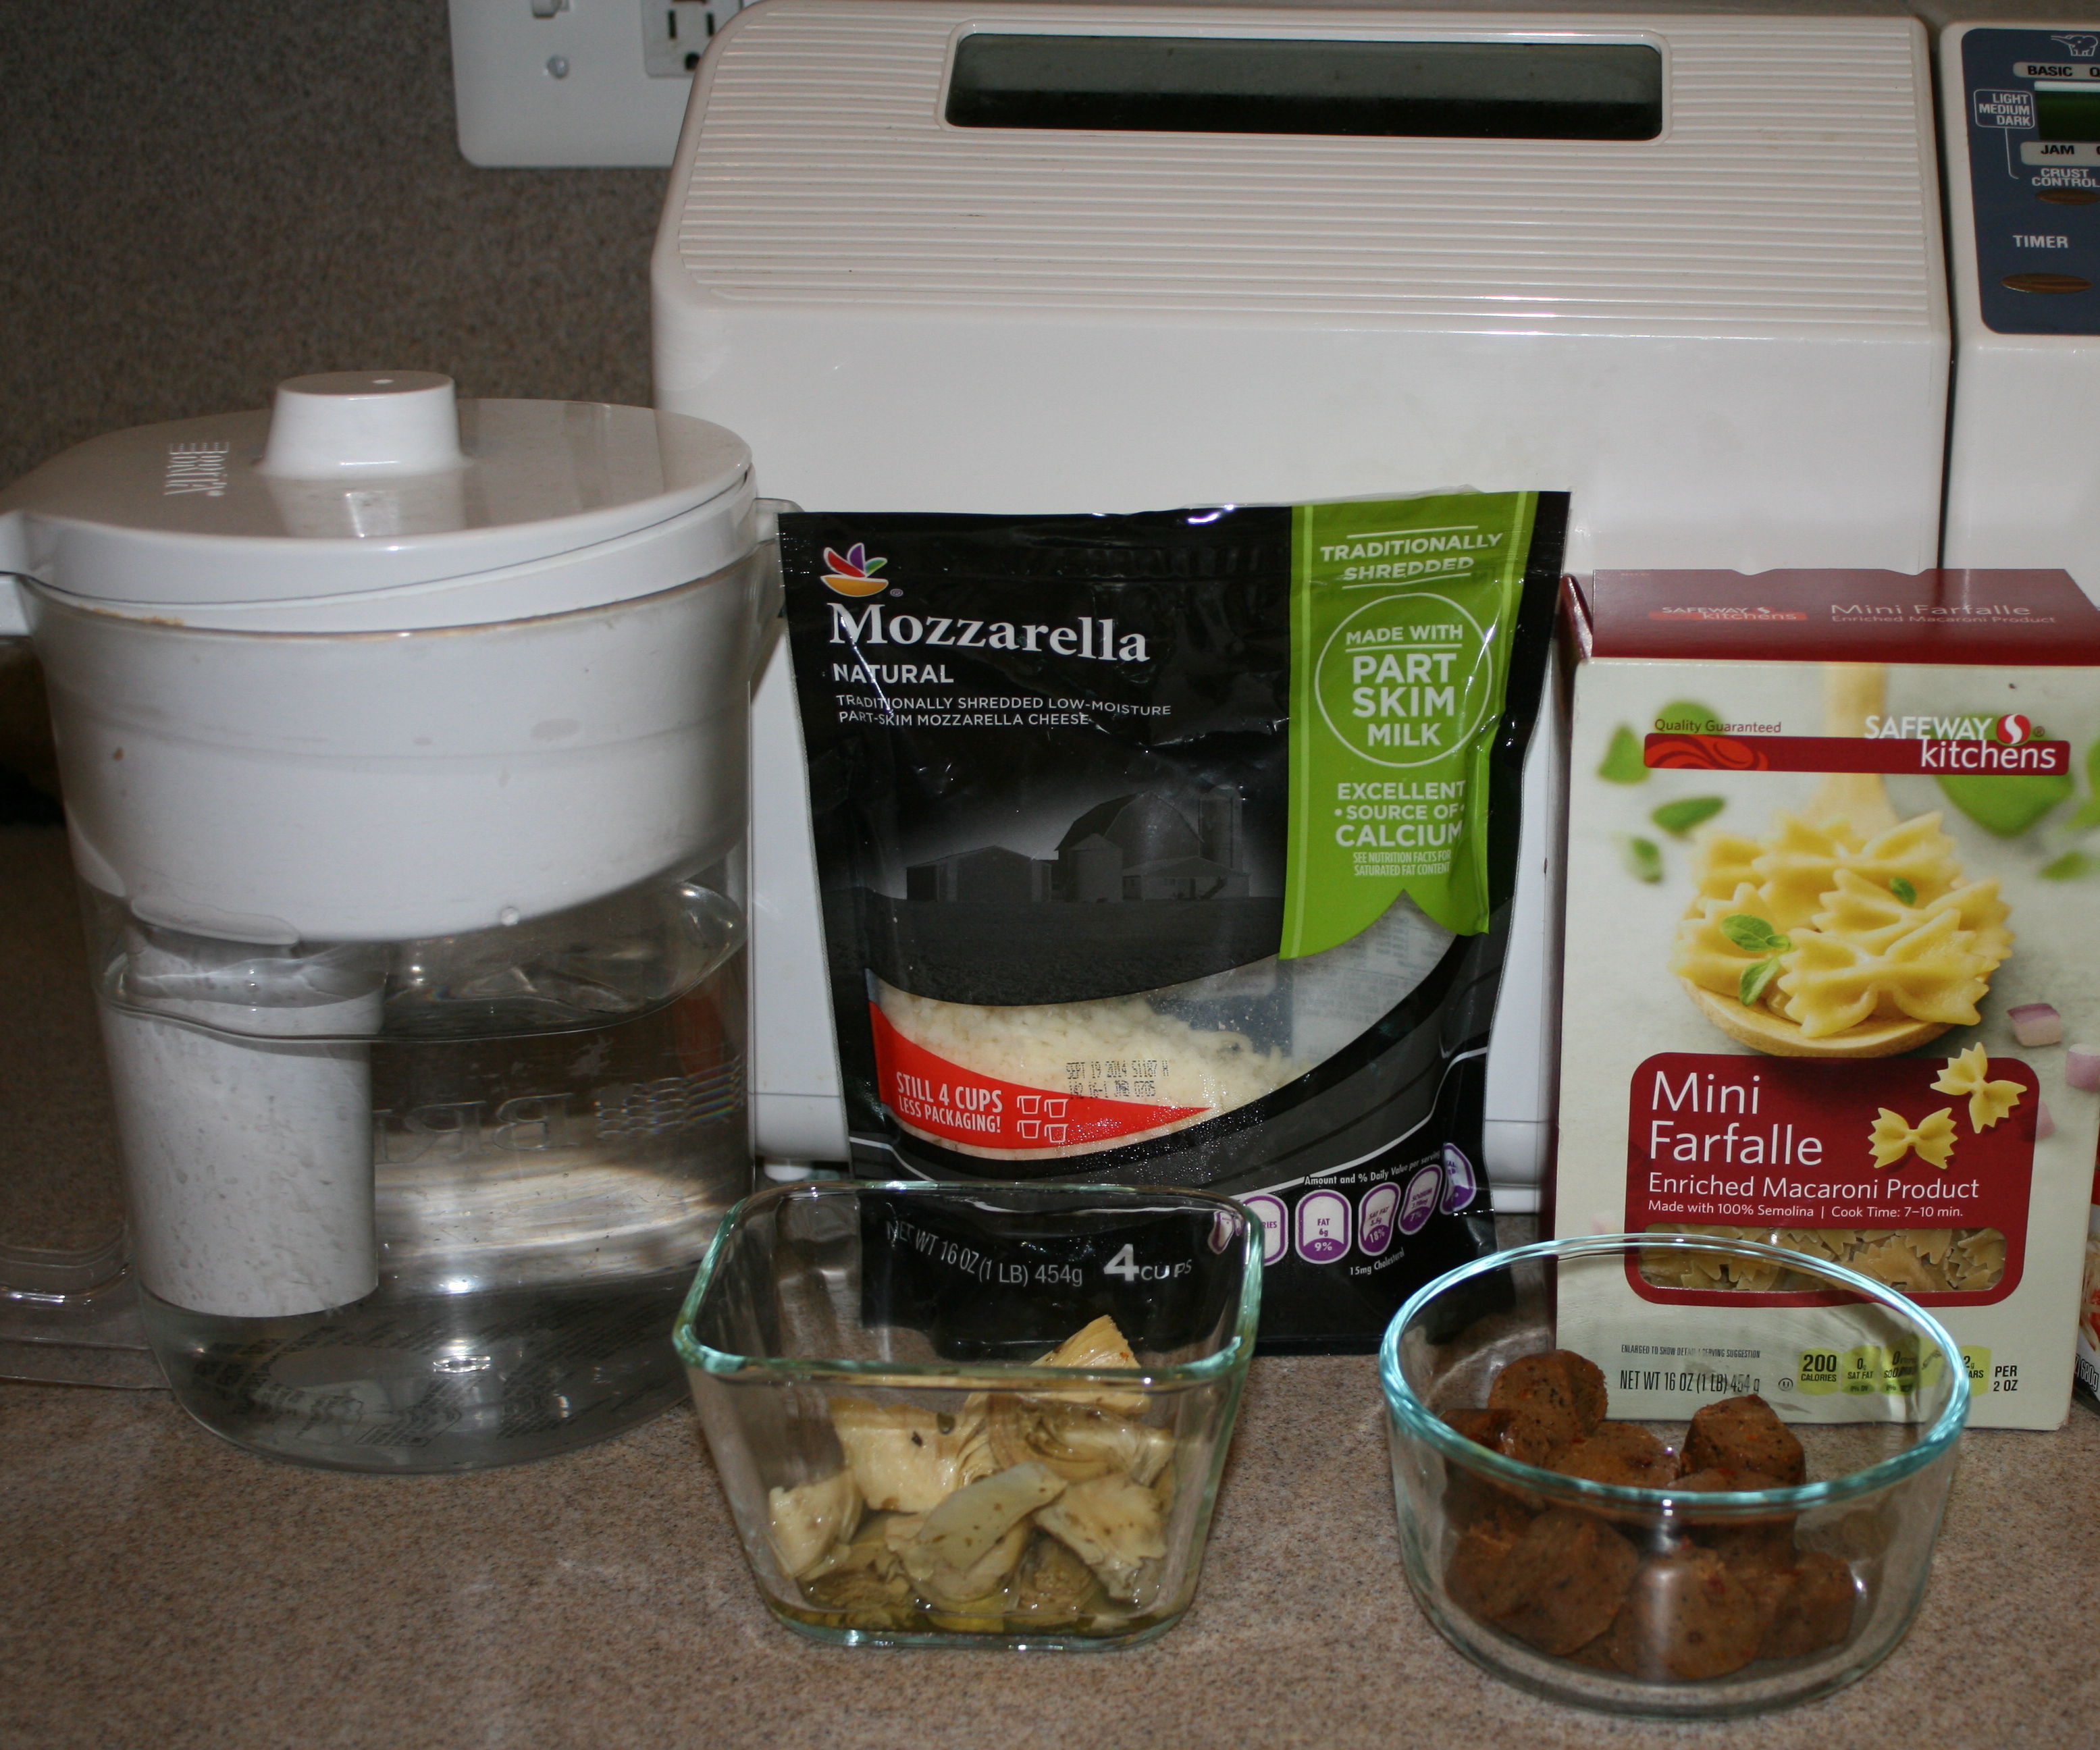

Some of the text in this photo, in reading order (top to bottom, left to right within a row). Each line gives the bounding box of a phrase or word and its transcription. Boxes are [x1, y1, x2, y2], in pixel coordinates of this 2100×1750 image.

[2028, 65, 2073, 77] BASIC
[1993, 94, 2028, 105] LIGHT
[1979, 104, 2030, 115] MEDIUM
[1997, 115, 2030, 126] DARK
[2041, 144, 2075, 155] JAM
[2032, 177, 2100, 188] CONTROL
[2041, 169, 2089, 178] CRUST
[2013, 236, 2068, 248] TIMER
[165, 455, 227, 496] BRITA
[1321, 533, 1502, 562] TRADITIONALLY
[1344, 557, 1474, 581] SHREDDED
[1703, 612, 1796, 620] kitchens
[1831, 604, 2031, 616] Mini Farfalle
[1832, 615, 2056, 625] Enriched Macaroni Product
[827, 603, 1150, 662] Mozzarella
[1346, 625, 1463, 644] MADE WITH
[833, 664, 953, 684] NATURAL
[1353, 654, 1456, 683] PART
[837, 695, 1171, 715] TRADITIONALLY SHREDDED LOW-MOISTURE
[1352, 687, 1454, 717] SKIM
[839, 712, 1089, 726] PART-SKIM MOZZARELLA CHEESE
[1654, 718, 1781, 735] Quality Guaranteed
[1864, 716, 1994, 740] SAFEWAY
[1368, 723, 1441, 746] MILK
[1920, 739, 2056, 769] kitchens
[1338, 780, 1466, 799] EXCELLENT
[1346, 804, 1459, 819] SOURCE OF
[1336, 823, 1463, 847] CALCIUM
[1353, 849, 1451, 863] SEE NUTRITION FACTS FOR
[1355, 861, 1450, 876] SATURATED FAT CONTENT
[896, 1071, 1003, 1114] STILL 4 CUPS
[1652, 1071, 1760, 1115] Mini
[899, 1099, 1001, 1134] LESS PACKAGING!
[1650, 1120, 1822, 1166] Farfalle
[1305, 1176, 1337, 1185] Amount
[1340, 1173, 1355, 1184] and
[1358, 1173, 1367, 1182] %
[1370, 1170, 1388, 1181] Daily
[1391, 1164, 1408, 1176] Value
[1409, 1160, 1420, 1171] per
[1649, 1172, 1979, 1199] Enriched Macaroni Product
[1649, 1200, 1683, 1213] Made
[1687, 1201, 1714, 1213] with
[1718, 1202, 1754, 1215] 100%
[1758, 1203, 1814, 1217] Semolina
[1832, 1206, 1862, 1218] Cook
[1867, 1206, 1901, 1218] Time:
[1937, 1207, 1963, 1217] min.
[1319, 1229, 1328, 1237] 6g
[1369, 1227, 1385, 1243] 18%
[1315, 1242, 1332, 1251] 9%
[916, 1231, 939, 1256] WT
[941, 1241, 957, 1263] 16
[959, 1248, 980, 1274] OZ
[999, 1263, 1028, 1287] LB)
[1035, 1265, 1082, 1287] 454g
[1103, 1244, 1192, 1281] 4 CUPS
[1350, 1247, 1405, 1275] 15mg Cholesterol
[1621, 1344, 1650, 1354] ENLARGED
[1652, 1346, 1658, 1354] TO
[1660, 1346, 1675, 1356] SHOW
[1727, 1350, 1760, 1358] SUGGESTION
[1803, 1354, 1837, 1372] 200
[1995, 1365, 2018, 1377] PER
[1621, 1370, 1640, 1389] NET
[1644, 1372, 1660, 1390] WT
[1664, 1373, 1675, 1391] 16
[1680, 1373, 1694, 1391] OZ
[1697, 1374, 1706, 1394] (1
[1710, 1374, 1727, 1394] LB)
[1801, 1373, 1837, 1382] CALORIES
[1847, 1371, 1873, 1379] SAT FAT
[1993, 1380, 2018, 1392] 2 OZ
